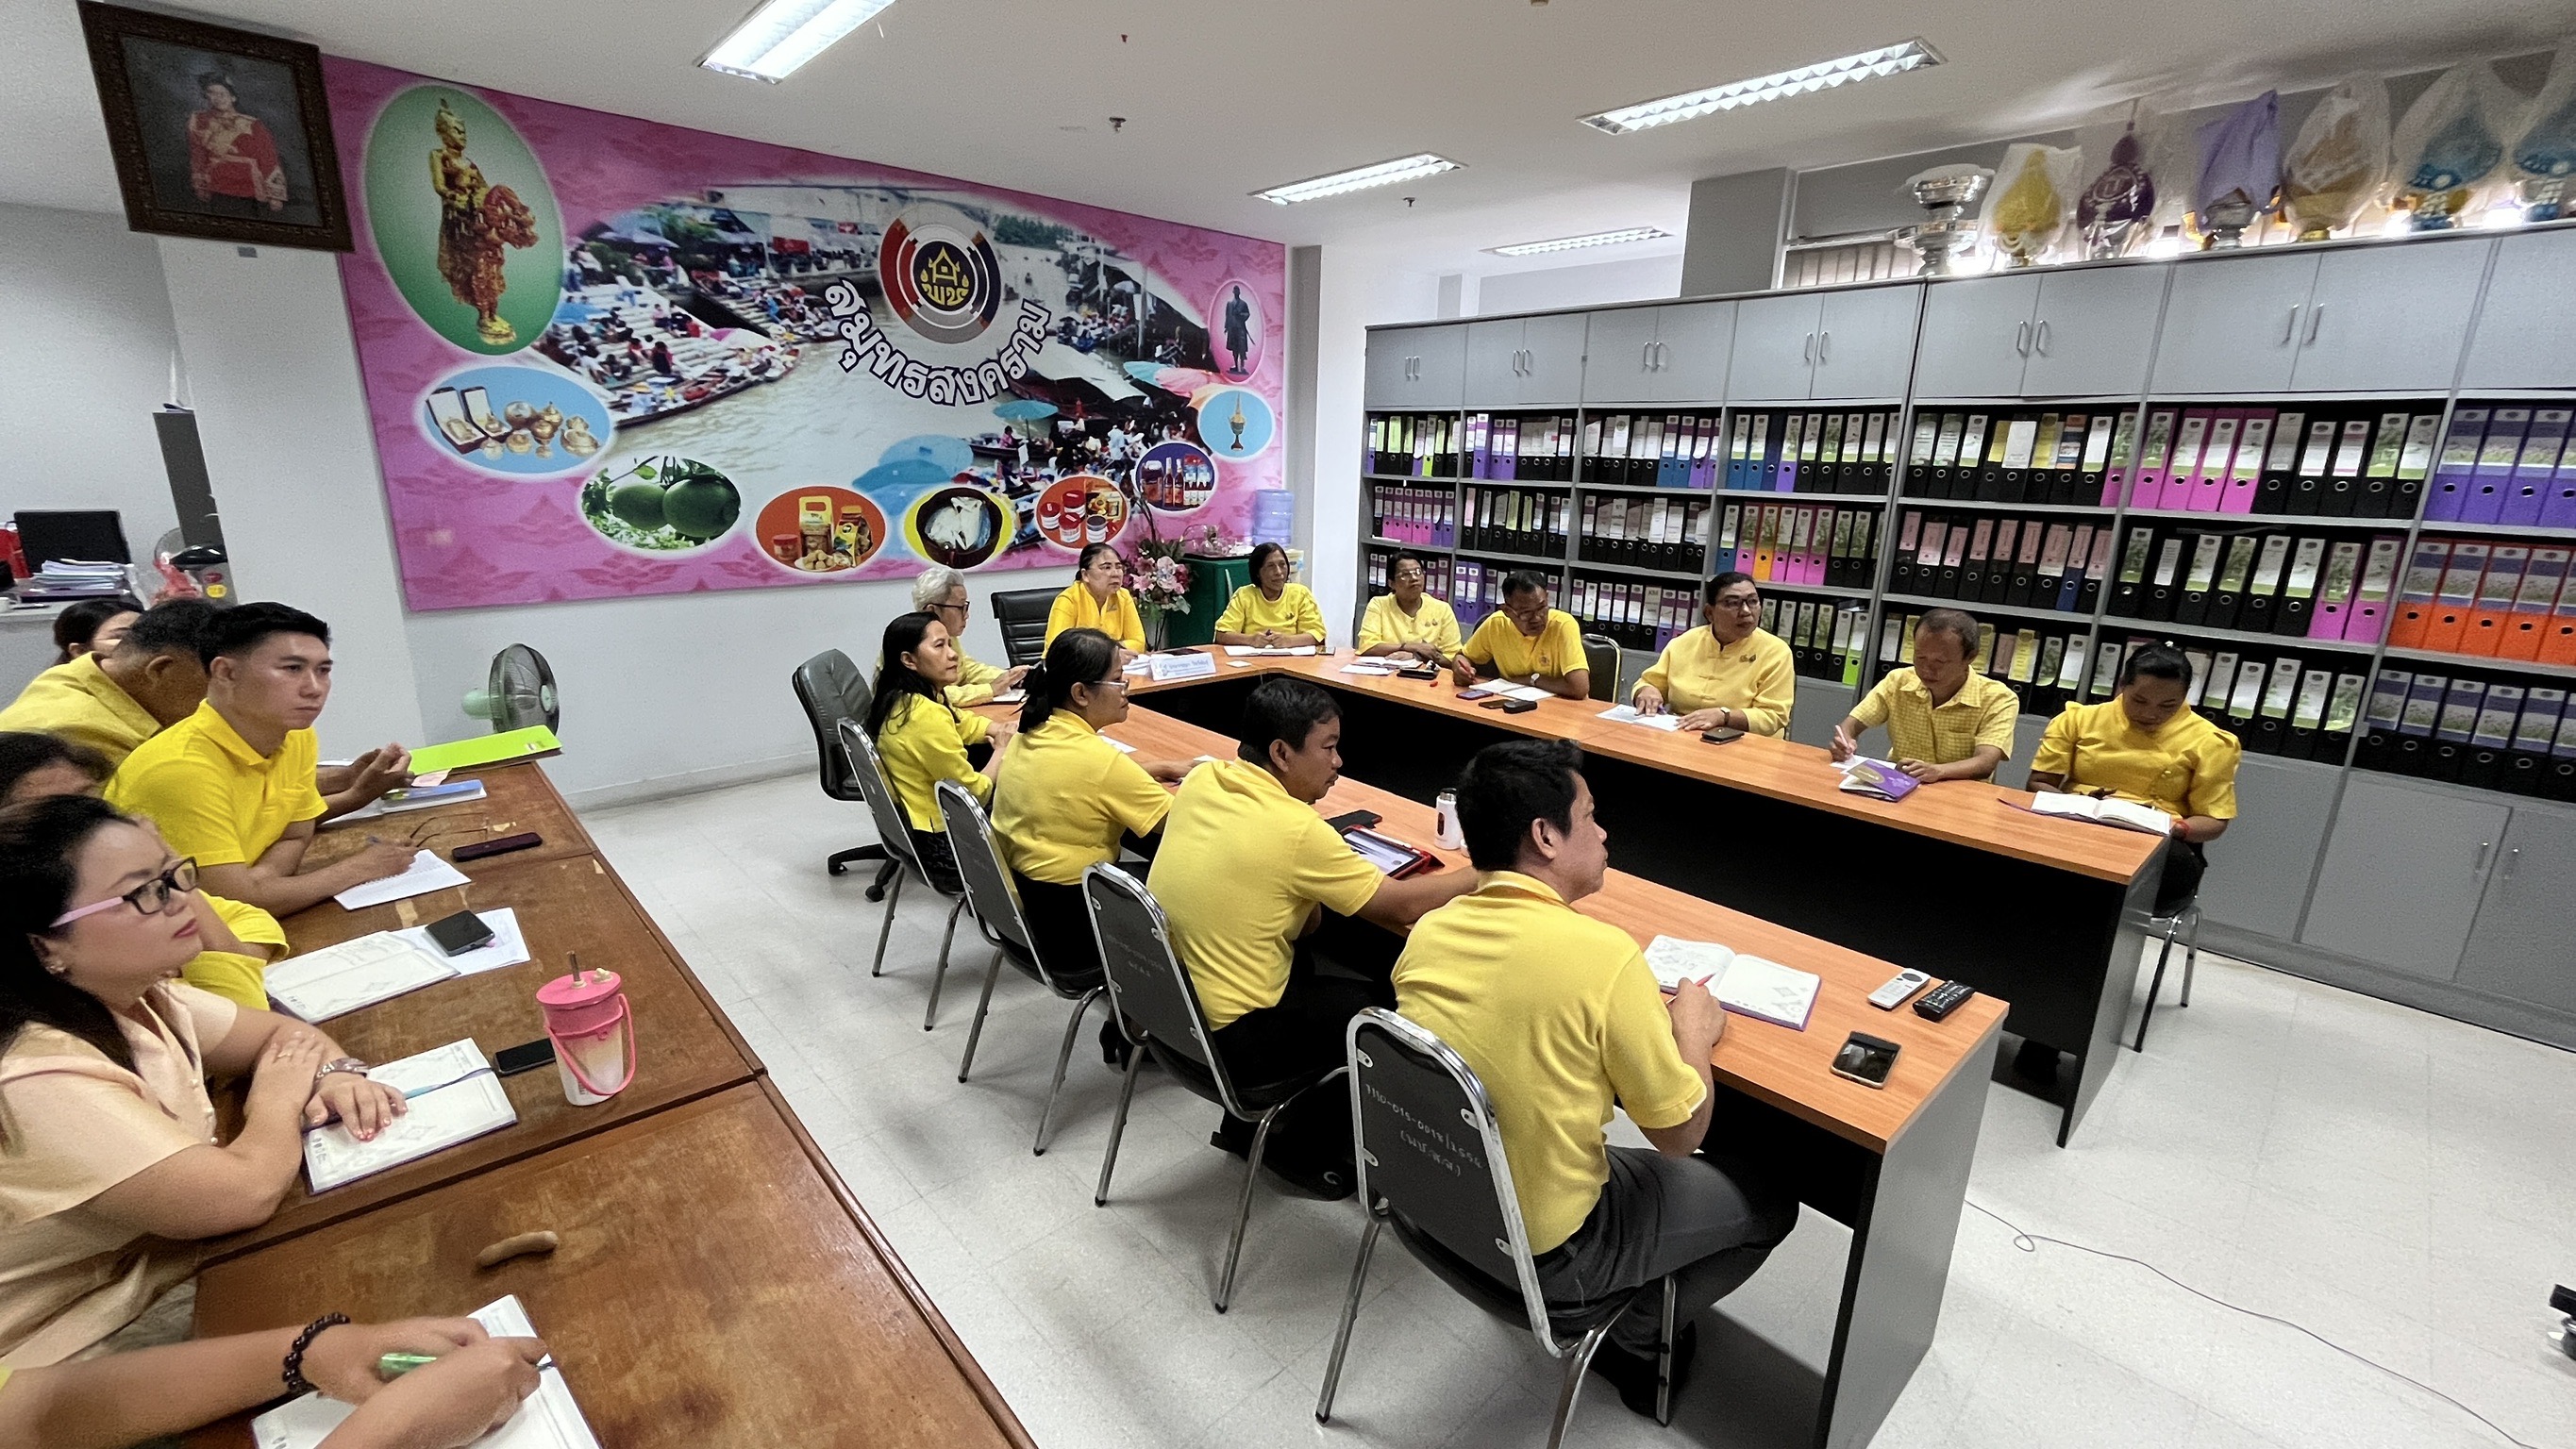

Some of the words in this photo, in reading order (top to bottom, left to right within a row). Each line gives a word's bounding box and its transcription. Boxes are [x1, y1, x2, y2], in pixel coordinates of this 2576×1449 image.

[824, 276, 1052, 407] สมุทรสงคราม
